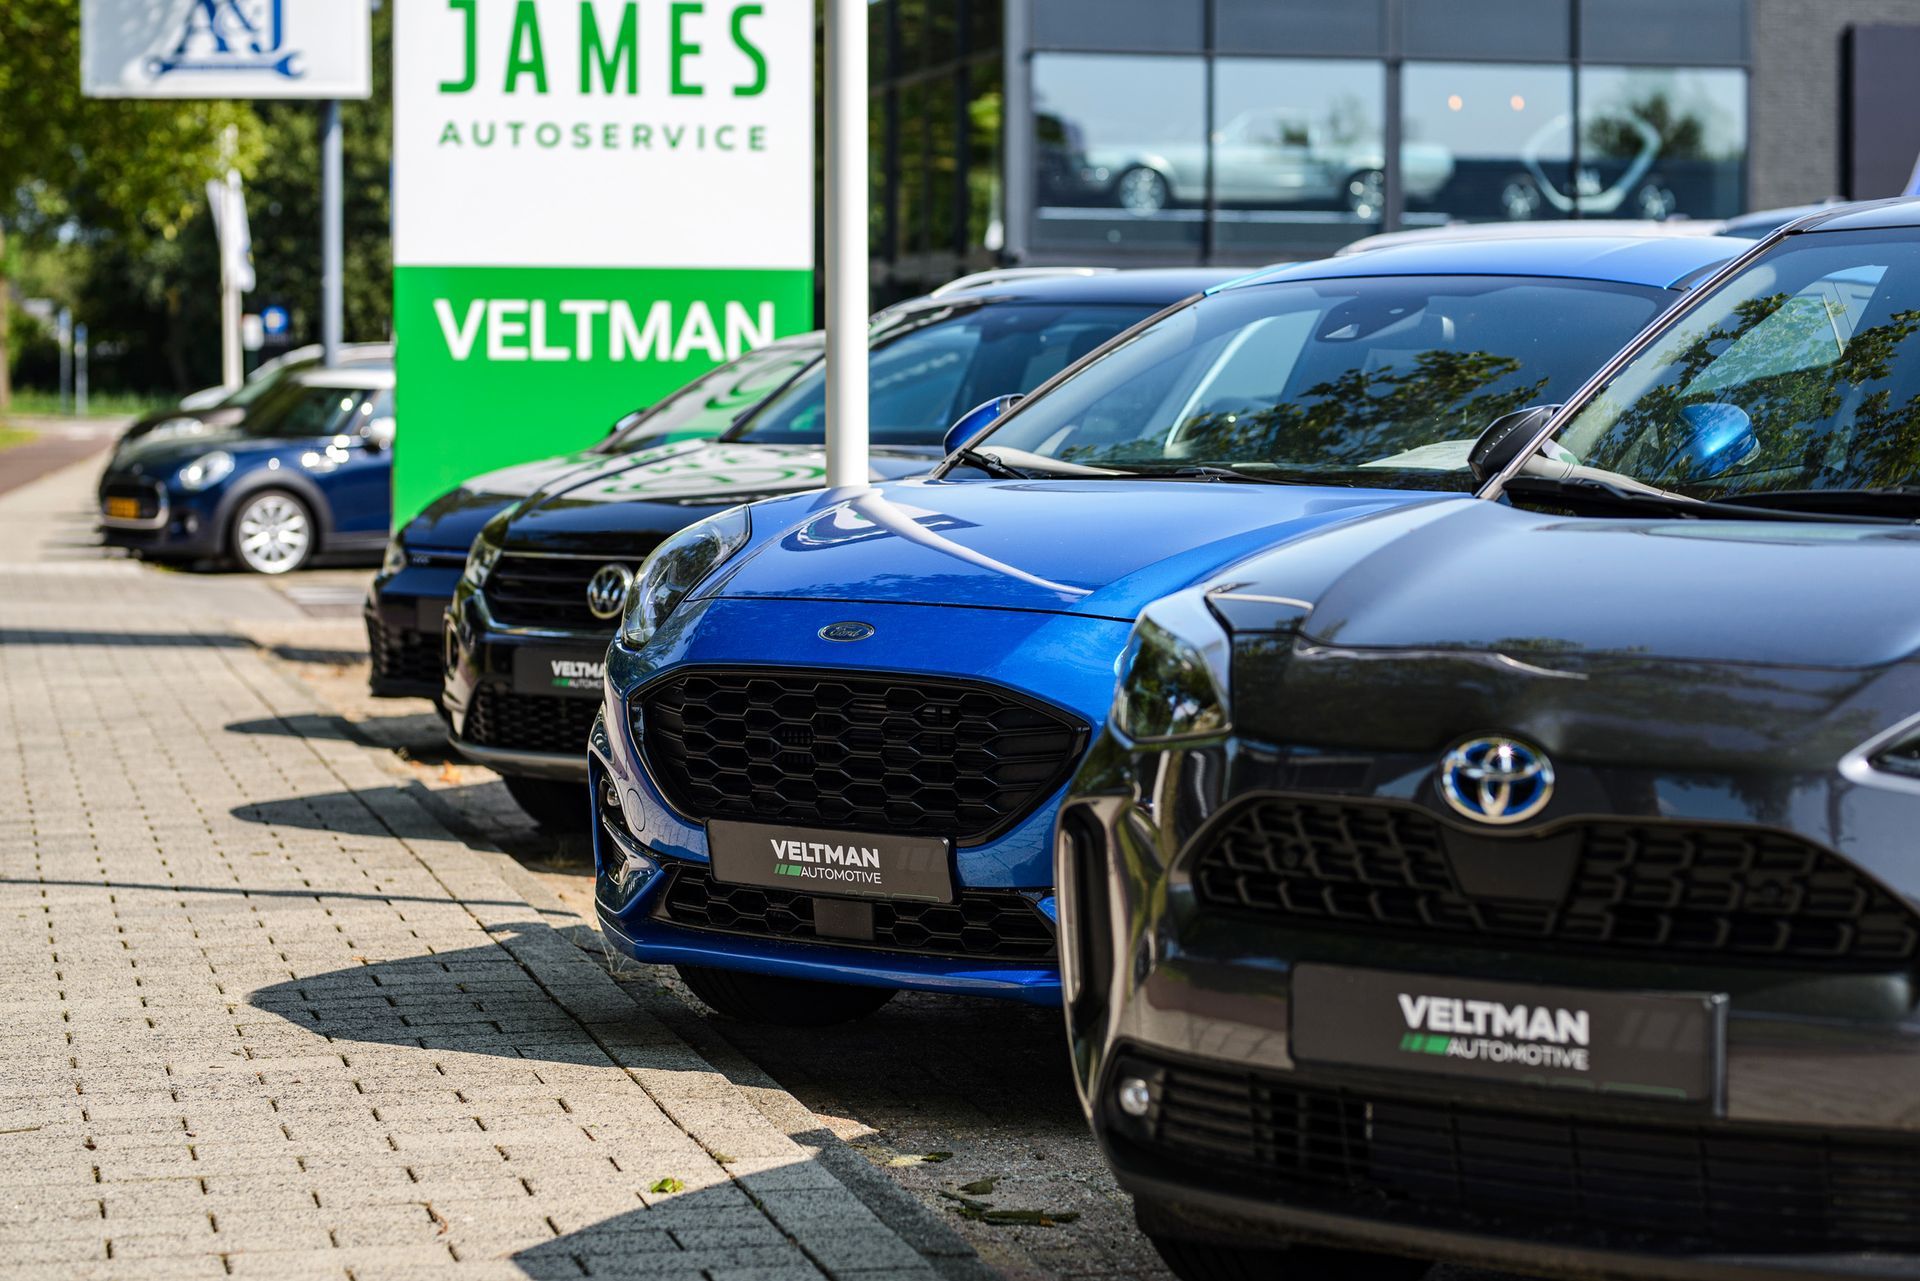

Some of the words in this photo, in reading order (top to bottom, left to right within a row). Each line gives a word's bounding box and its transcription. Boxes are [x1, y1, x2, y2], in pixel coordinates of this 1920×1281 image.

[438, 0, 769, 96] JAMES
[438, 120, 768, 151] AUTOSERVICE
[433, 298, 776, 361] VELTMAN
[551, 660, 605, 678] VELTMA
[568, 678, 605, 689] AUTOMO
[770, 839, 881, 868] VELTMAN
[800, 866, 882, 884] AUTOMOTIVE
[1398, 993, 1590, 1046] VELTMAN
[1446, 1037, 1590, 1071] AUTOMOTIVE
